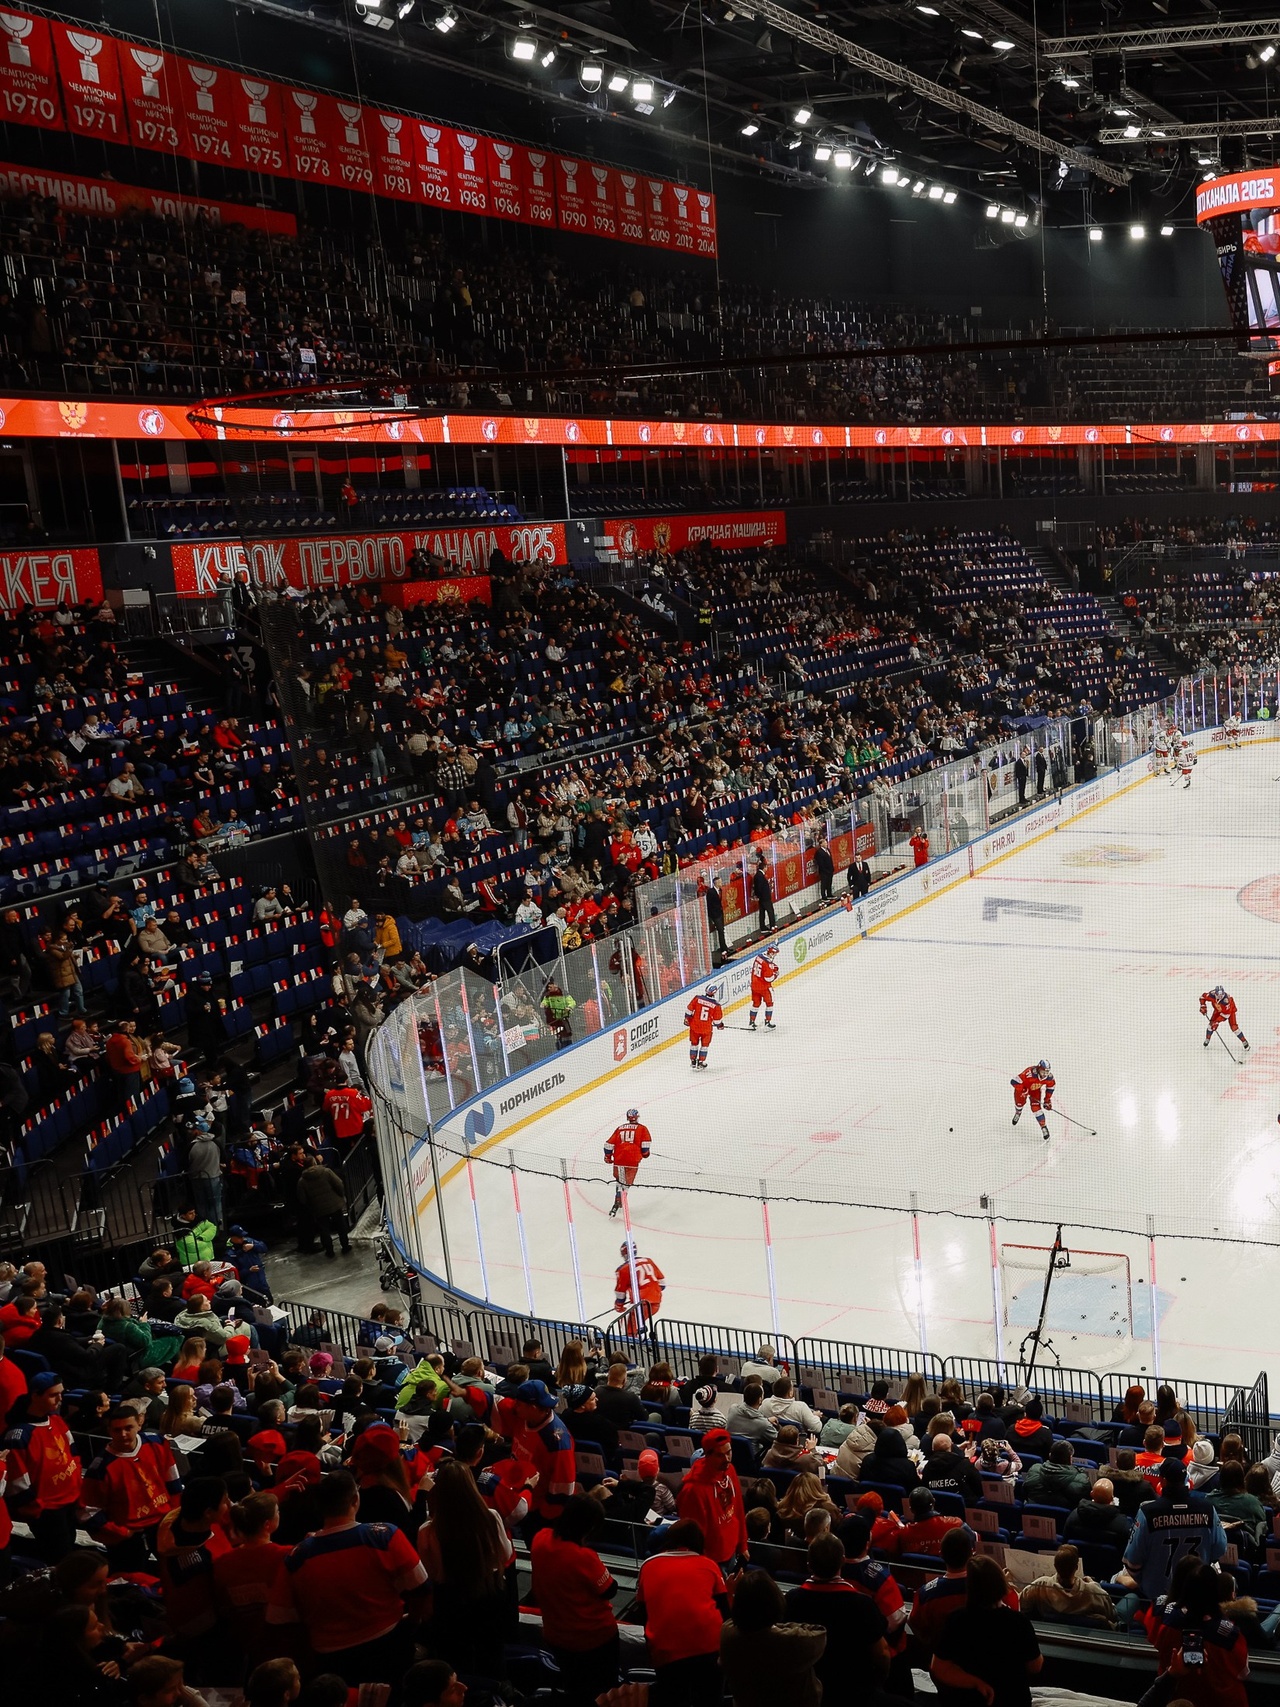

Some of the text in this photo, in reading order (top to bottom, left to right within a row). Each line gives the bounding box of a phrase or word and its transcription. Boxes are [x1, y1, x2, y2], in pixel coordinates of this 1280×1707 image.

[69, 82, 116, 100] ЧЕМПИОНЫ
[3, 90, 54, 120] 1970
[132, 98, 174, 114] ЧЕМПИОНЫ
[74, 105, 117, 133] 1971
[187, 112, 228, 127] ЧЕМПИОНЫ
[136, 120, 179, 146] 1973
[239, 124, 279, 139] ЧЕМПИОНЫ
[192, 133, 231, 158] 1974
[242, 145, 283, 169] 1975
[295, 154, 330, 177] 1978
[340, 163, 373, 186] 1979
[383, 174, 411, 194] 1981
[421, 182, 451, 203] 1982
[459, 188, 486, 209] 1983
[1206, 183, 1240, 211] КАНАЛА
[1241, 178, 1274, 201] 2025
[494, 196, 521, 216] 1986
[530, 203, 553, 220] 1989
[561, 210, 587, 228] 1990
[592, 215, 616, 234] 1993
[620, 222, 643, 239] 2008
[649, 227, 671, 244] 2009
[674, 233, 694, 249] 2012
[697, 238, 715, 254] 2014
[1217, 244, 1237, 254] БИРЬ
[688, 522, 766, 541] КРАСНАЯ МАШИНА
[193, 543, 286, 595] КУБОК
[299, 536, 405, 585] ПЕРВОГО
[511, 527, 555, 564] 2025
[0, 554, 78, 609] КЕЯ
[992, 831, 1016, 853] FHR.RU
[807, 929, 834, 950] Airlines
[732, 979, 751, 996] КАНА
[699, 1007, 710, 1021] 6
[630, 1016, 660, 1041] СПОРТ
[630, 1030, 660, 1051] ЭКСПРЕСС
[499, 1072, 566, 1116] НОРНИКЕЛЬ
[331, 1103, 350, 1121] 77
[619, 1131, 635, 1144] 14
[637, 1263, 659, 1287] 24
[928, 1479, 944, 1489] NIKE
[1162, 1536, 1203, 1578] 73
